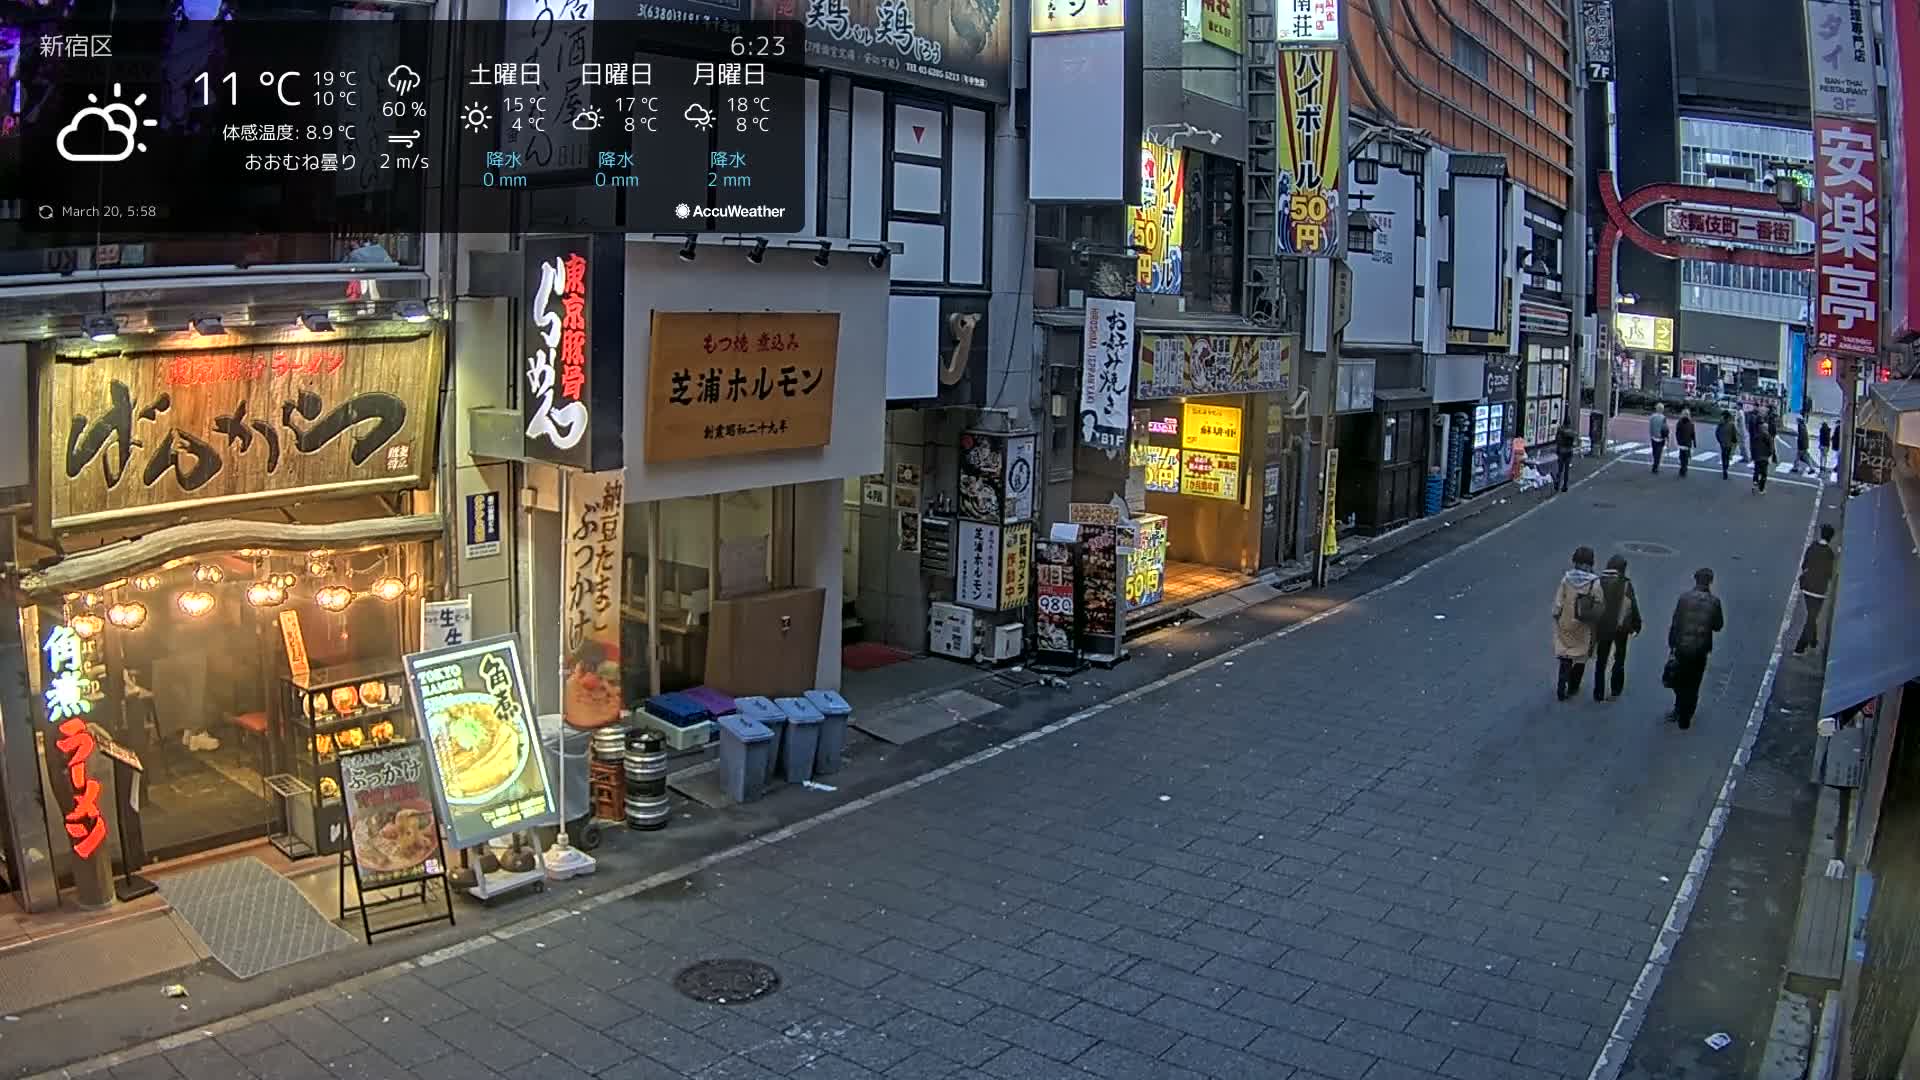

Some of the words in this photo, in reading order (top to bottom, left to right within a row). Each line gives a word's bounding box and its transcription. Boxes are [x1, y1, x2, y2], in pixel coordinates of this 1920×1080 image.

[1590, 64, 1610, 78] 7F
[1295, 54, 1323, 189] ハイボール
[1162, 152, 1176, 288] ハイボール
[1290, 196, 1328, 251] 50円
[1671, 208, 1791, 242] 歌舞伎町一番街
[1819, 126, 1876, 330] 安楽亭
[561, 253, 587, 400] 東京豚骨
[703, 333, 748, 353] もつ焼
[757, 331, 800, 352] 煮込み
[1819, 332, 1837, 347] 2F
[1100, 309, 1129, 415] お好み焼き
[669, 365, 823, 406] 芝浦ホルモン
[703, 419, 789, 439] 創業昭和二十九年
[1100, 433, 1126, 447] B1F
[440, 607, 455, 628] 生
